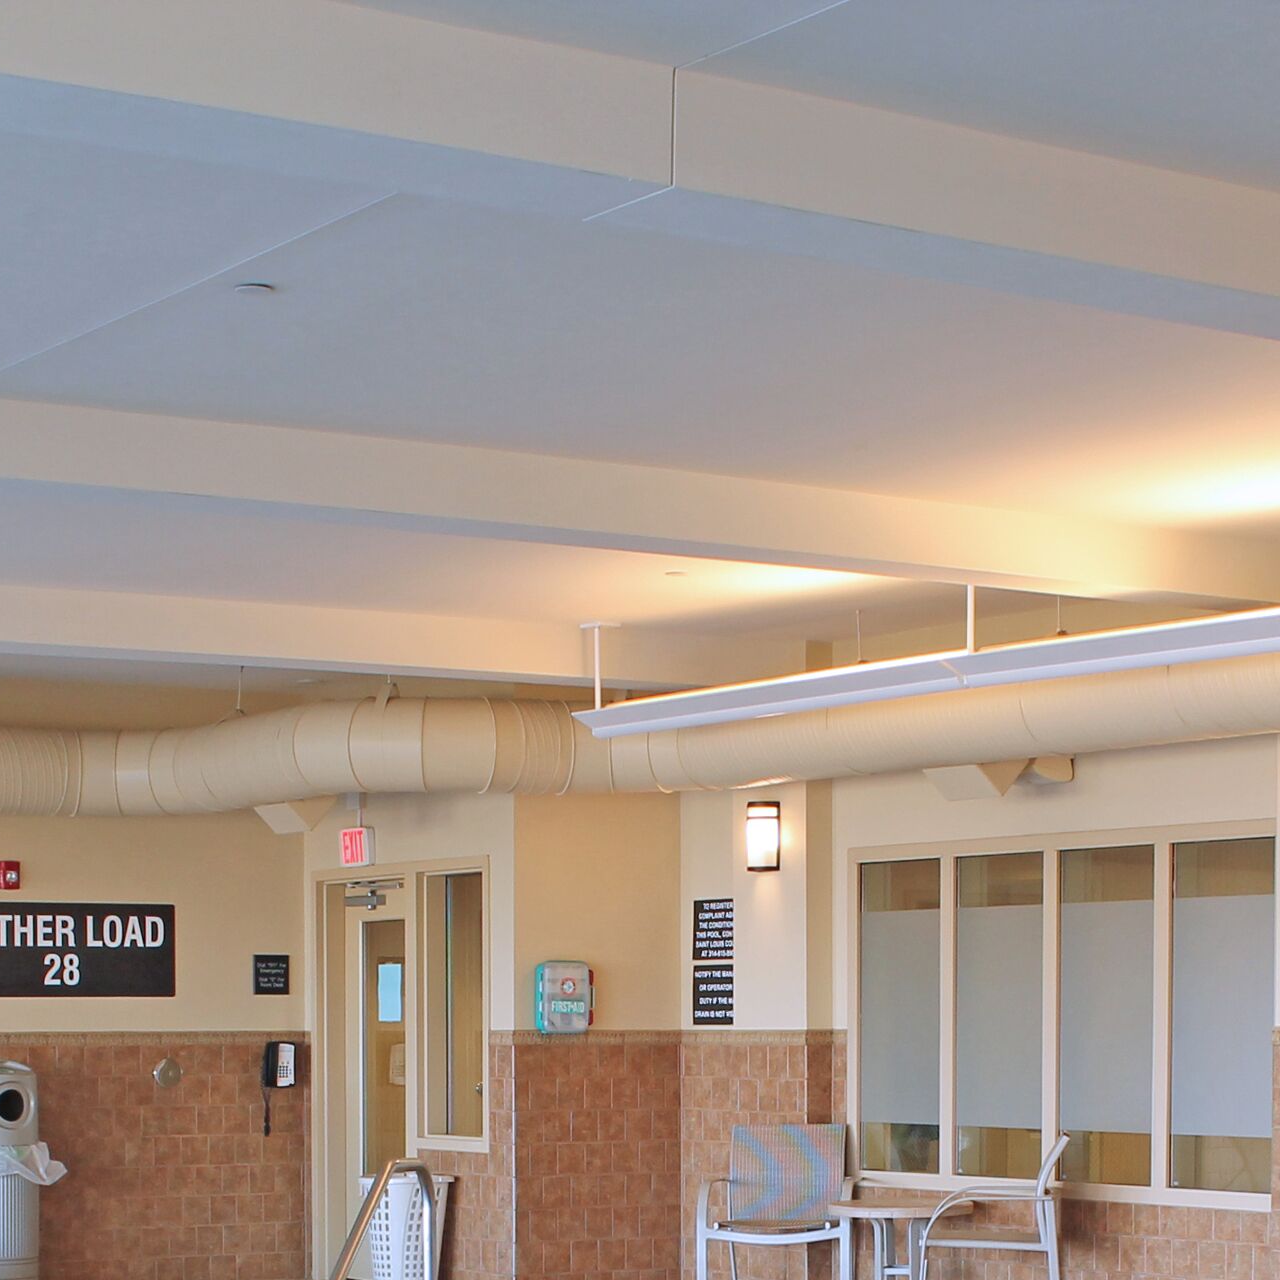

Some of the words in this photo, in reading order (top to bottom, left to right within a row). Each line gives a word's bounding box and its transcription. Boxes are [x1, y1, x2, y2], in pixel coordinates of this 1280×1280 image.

[342, 831, 364, 864] EXIT
[86, 915, 165, 948] LOAD
[43, 953, 81, 986] 28
